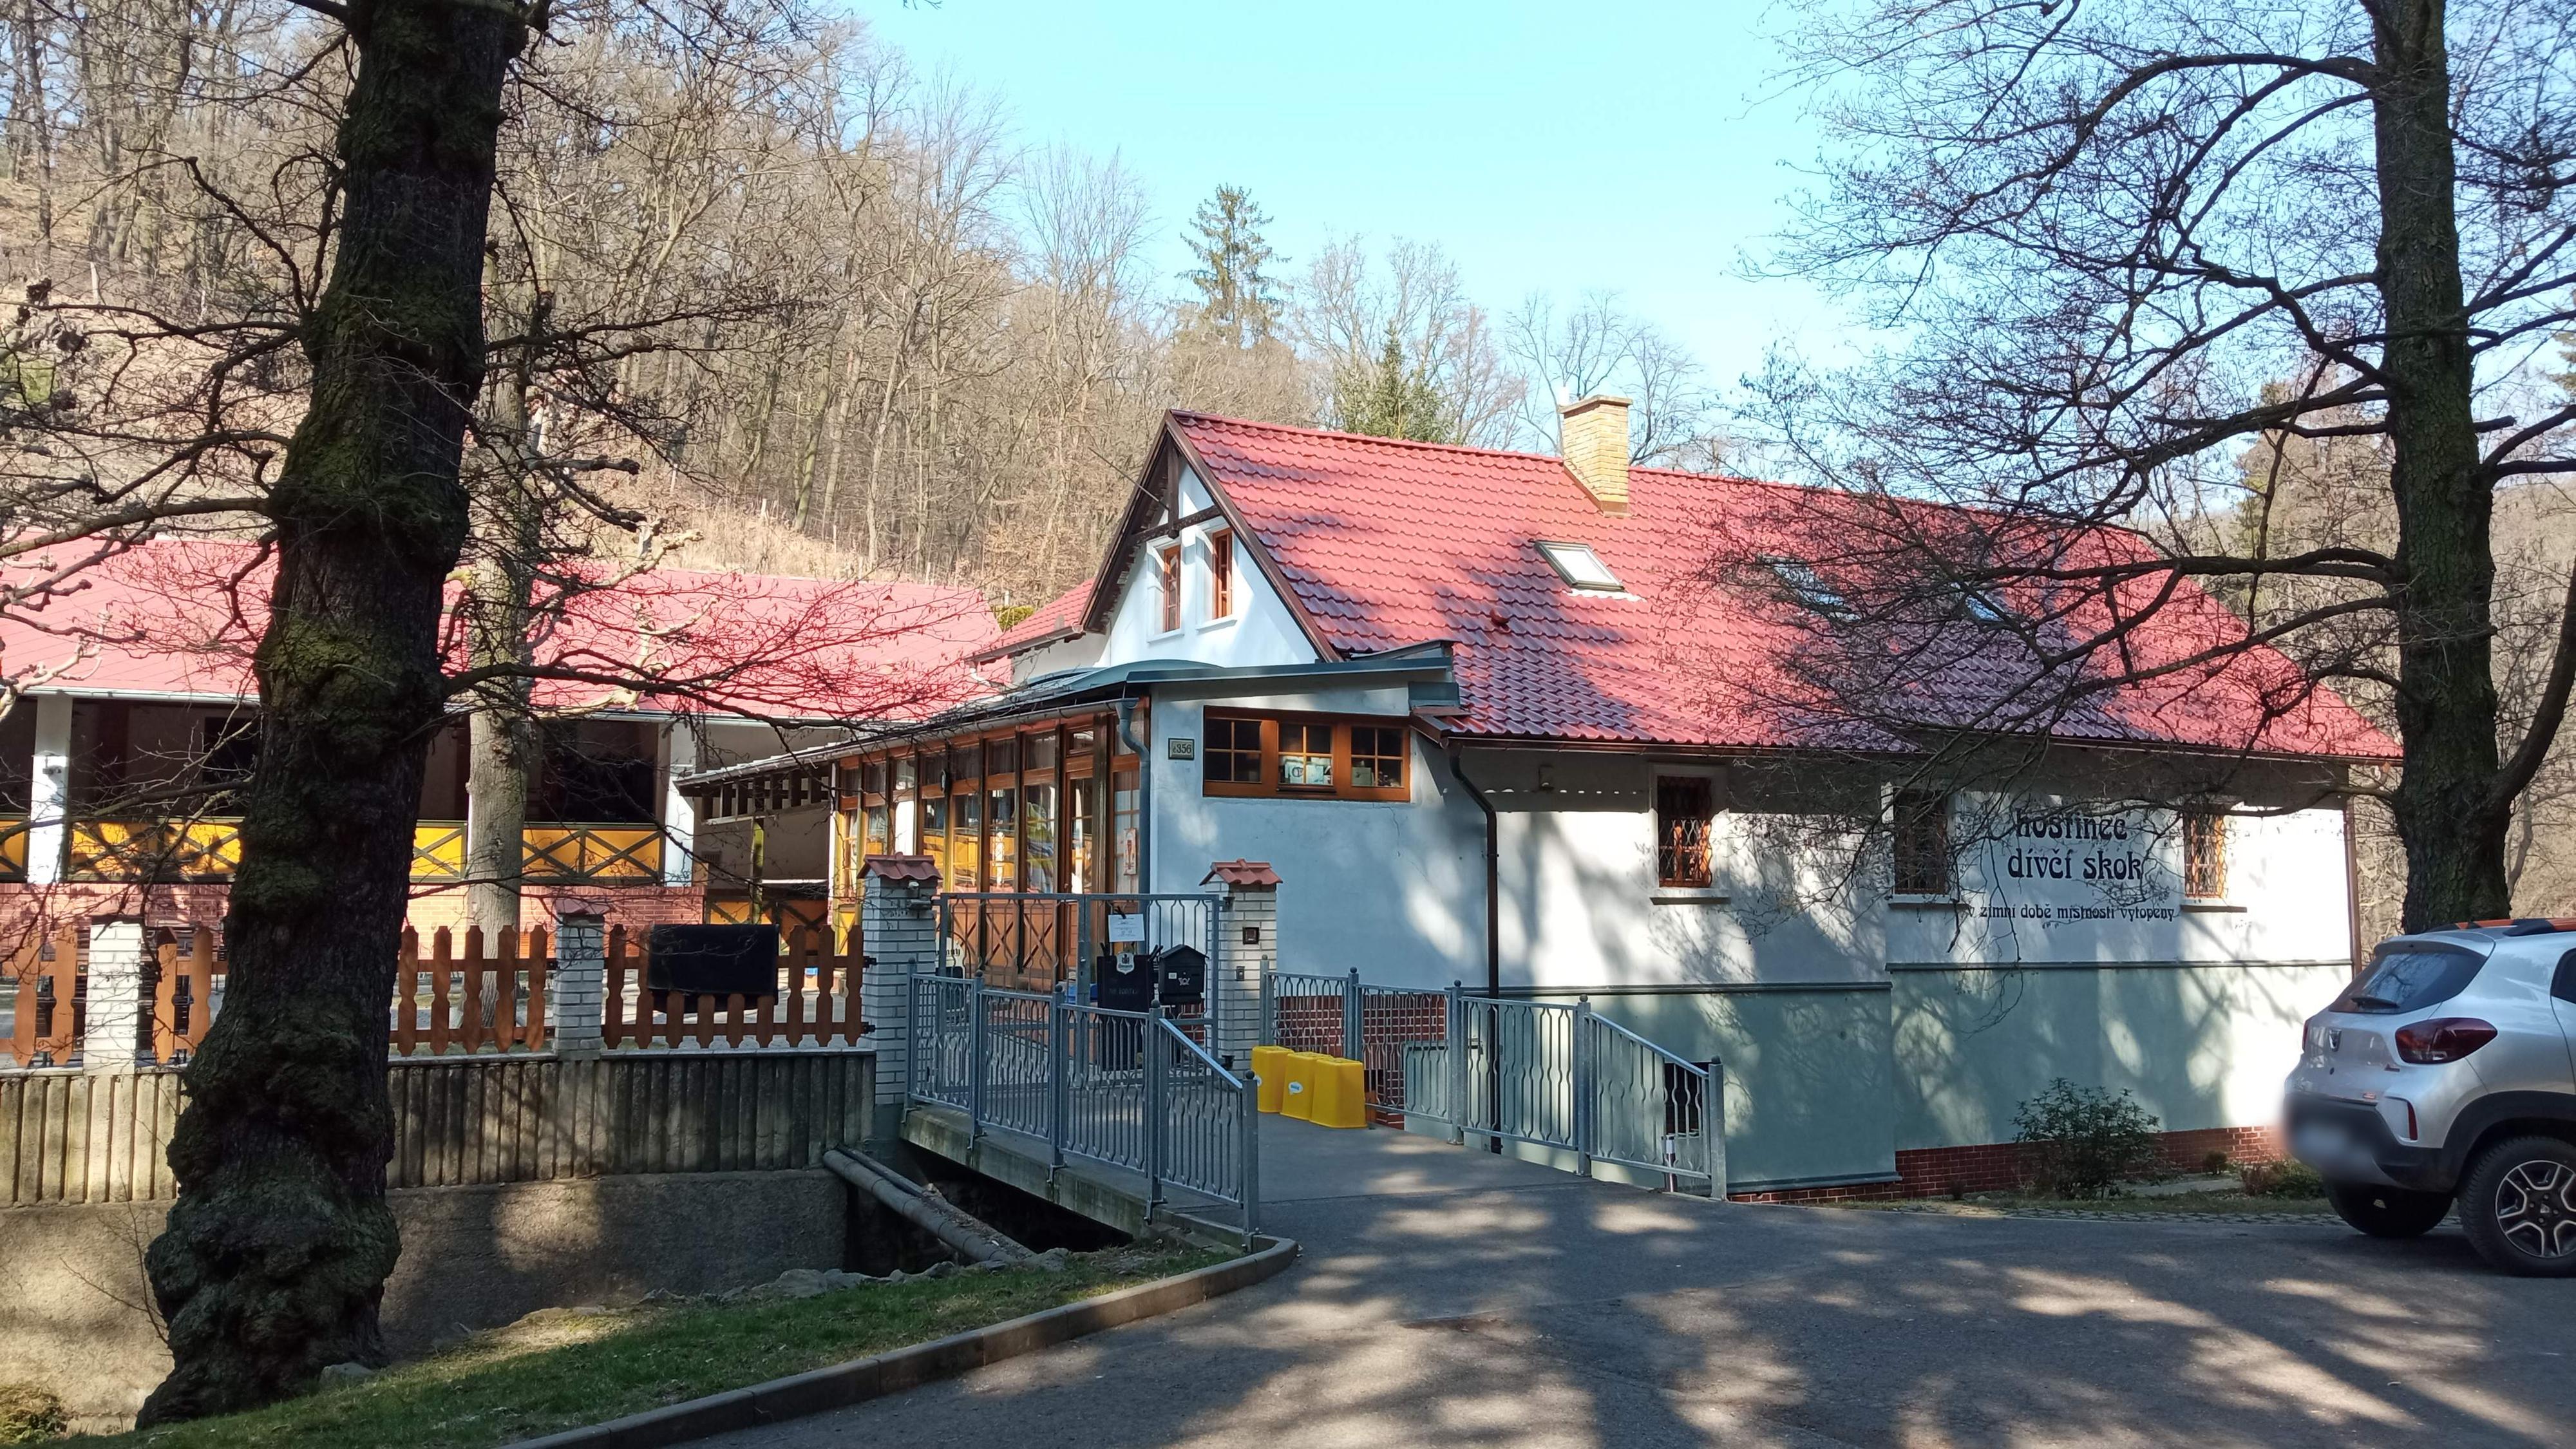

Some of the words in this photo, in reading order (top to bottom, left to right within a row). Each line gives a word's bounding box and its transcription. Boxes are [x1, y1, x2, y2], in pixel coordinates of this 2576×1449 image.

[2007, 848, 2072, 879] dívčí
[2083, 850, 2141, 880] skok
[2020, 904, 2052, 918] době
[2121, 906, 2175, 922] vytopeny
